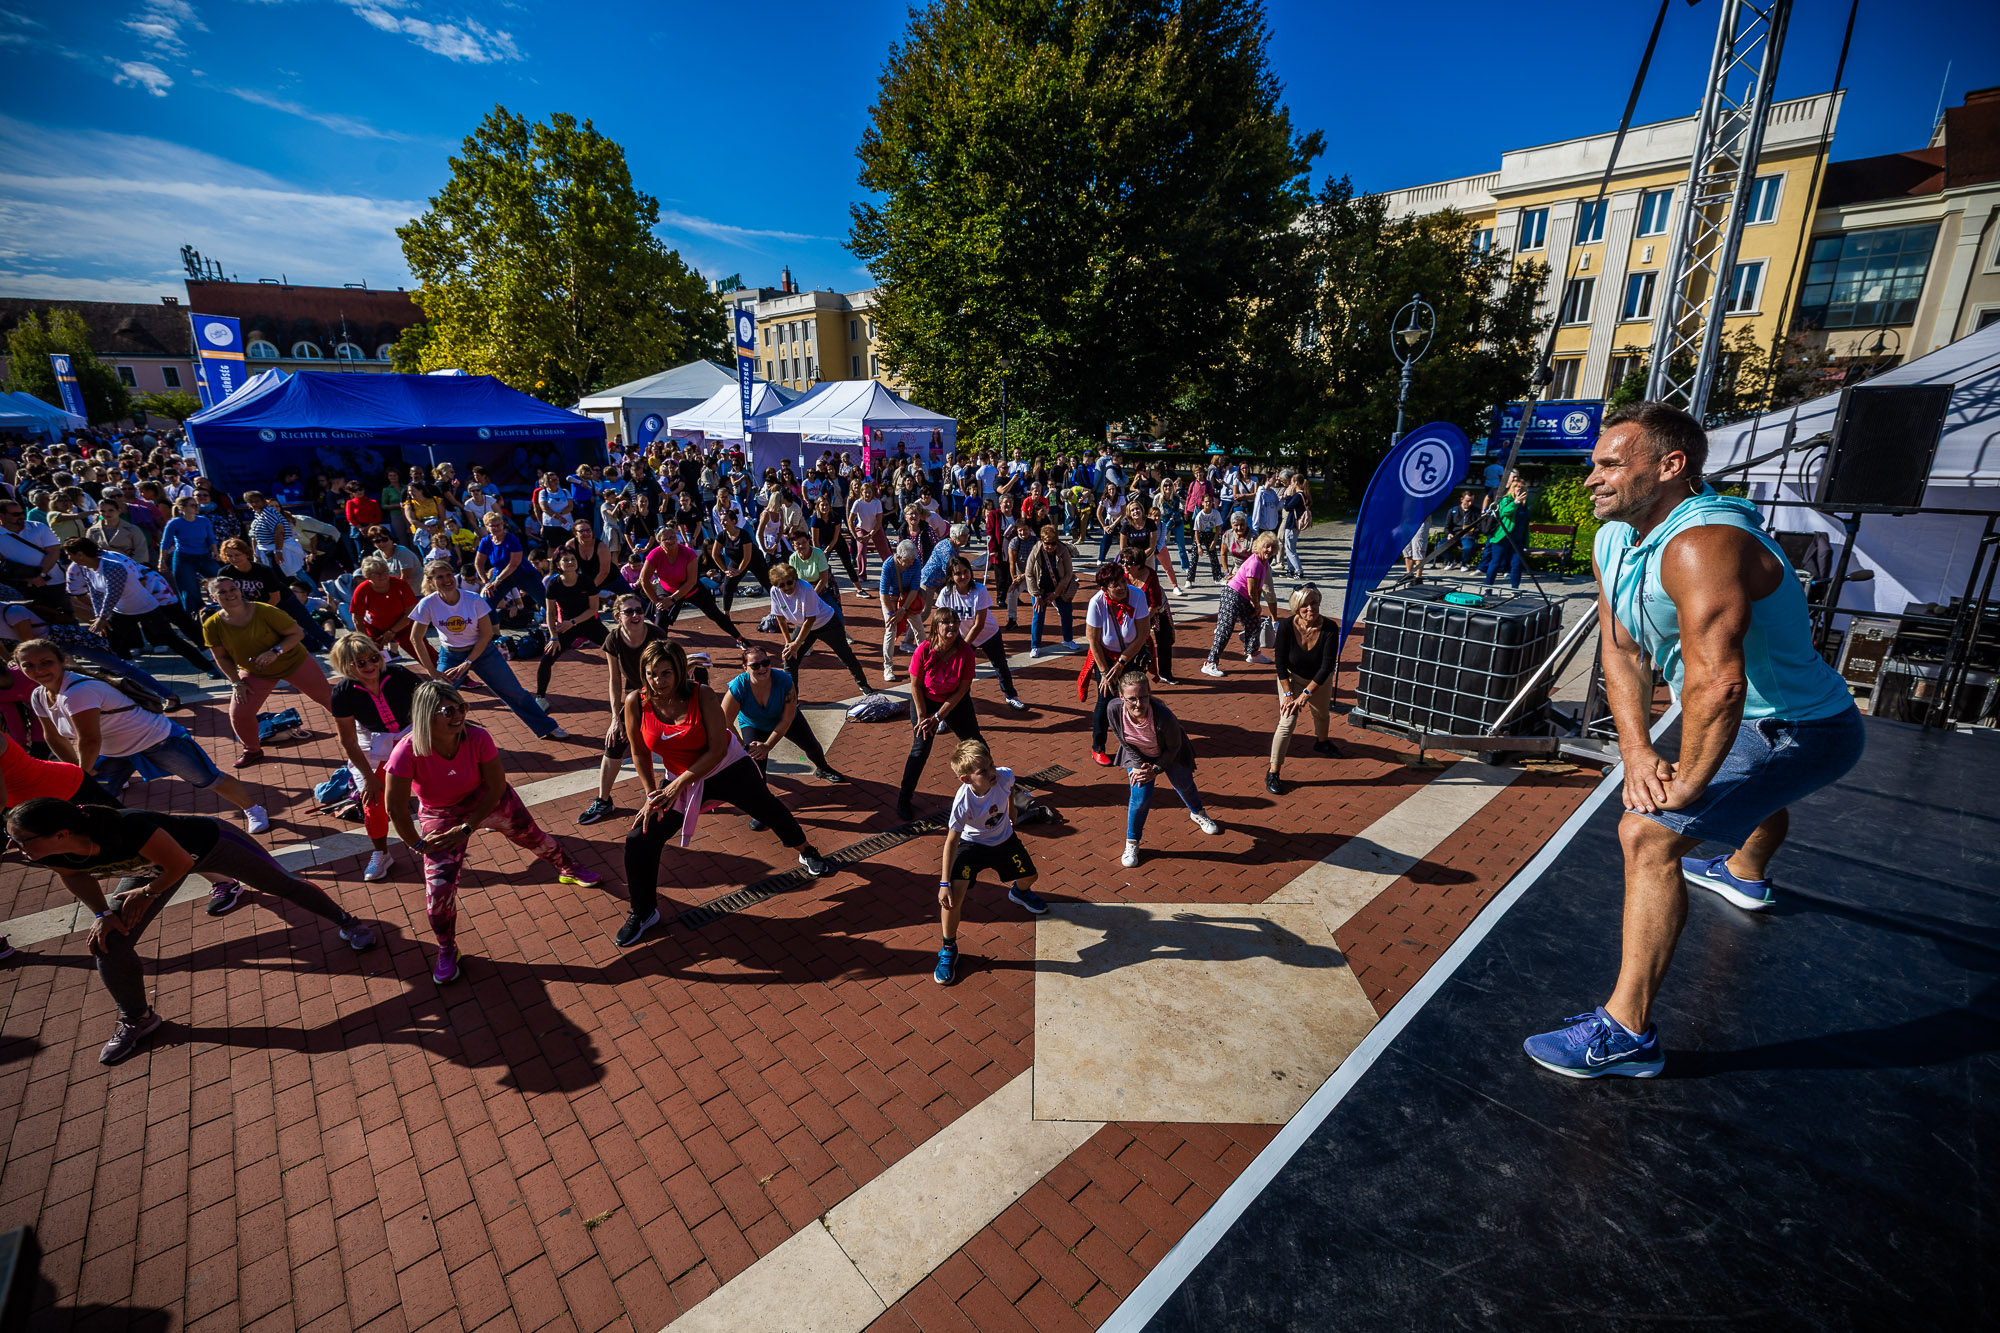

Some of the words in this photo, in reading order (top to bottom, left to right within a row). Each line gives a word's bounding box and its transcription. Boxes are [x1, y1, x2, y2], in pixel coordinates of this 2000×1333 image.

[1501, 415, 1558, 429] Relex
[280, 431, 328, 440] RICHTER
[331, 430, 374, 440] GEDEON
[494, 429, 530, 437] RICHTER
[532, 428, 565, 436] GEDEON
[1415, 451, 1438, 485] RG
[1012, 854, 1022, 868] 5
